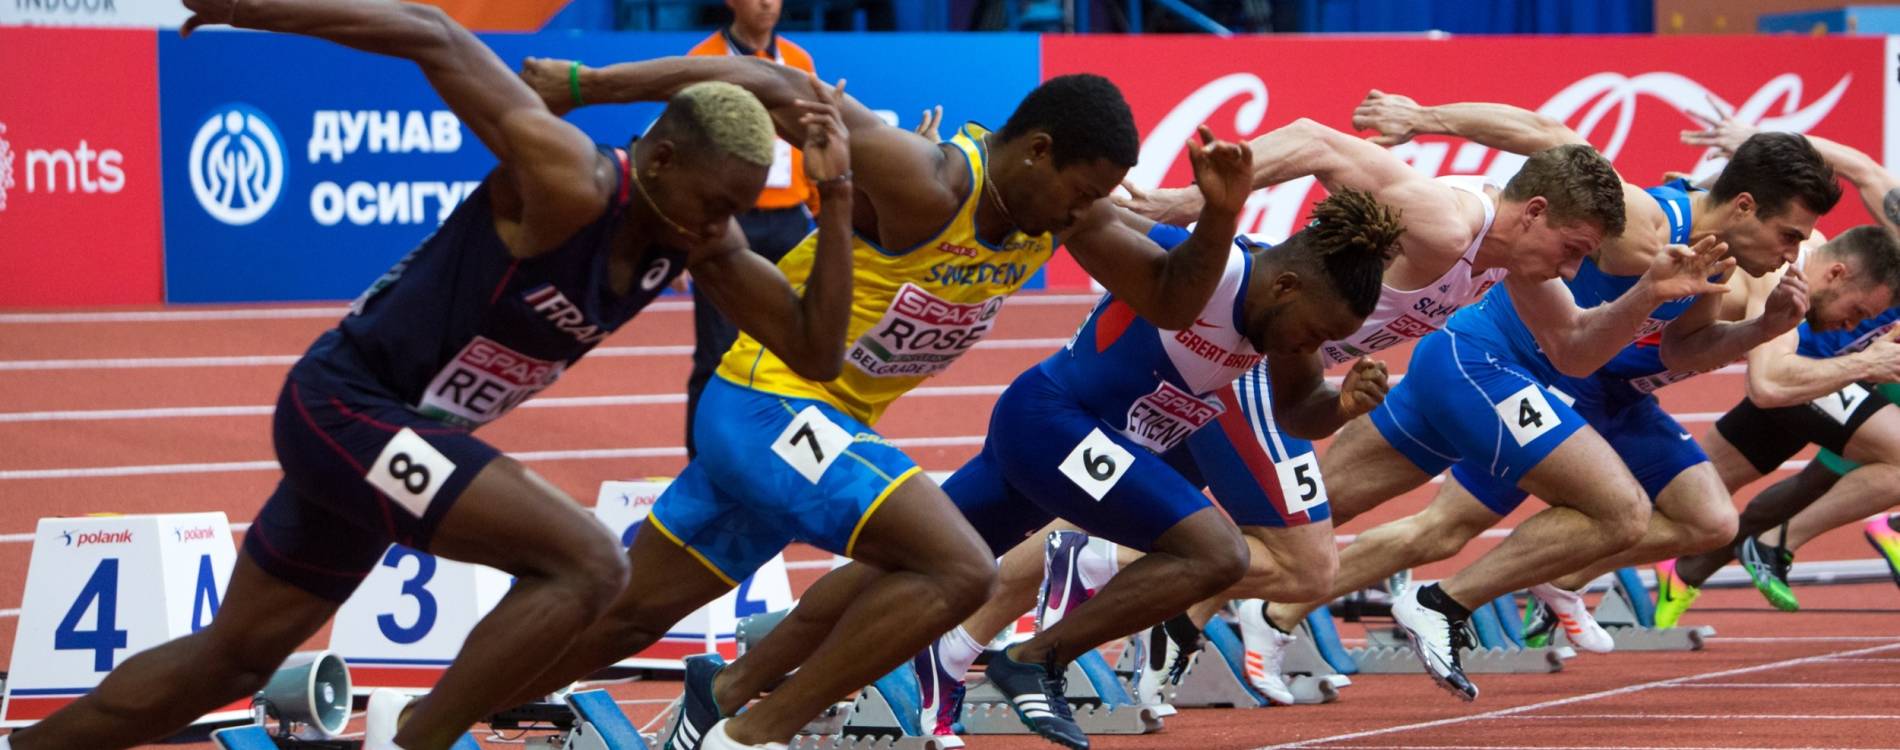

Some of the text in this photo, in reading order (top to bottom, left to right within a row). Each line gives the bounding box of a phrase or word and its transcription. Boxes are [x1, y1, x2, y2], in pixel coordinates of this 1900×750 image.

[308, 111, 461, 164] ДУНАВ
[26, 139, 125, 193] mts
[924, 262, 1027, 286] SWEDEN
[900, 291, 982, 324] SPAR
[879, 317, 987, 350] ROSE
[1174, 328, 1227, 363] GREAT
[851, 347, 927, 375] BELGRADE
[1150, 388, 1211, 424] SPAR
[1519, 397, 1543, 428] 4
[790, 422, 824, 464] 7
[389, 452, 430, 494] 8
[1083, 447, 1116, 481] 6
[1294, 463, 1317, 501] 5
[77, 530, 133, 547] polanik
[184, 526, 215, 543] polanik
[377, 543, 437, 644] 3
[55, 558, 127, 672] 4
